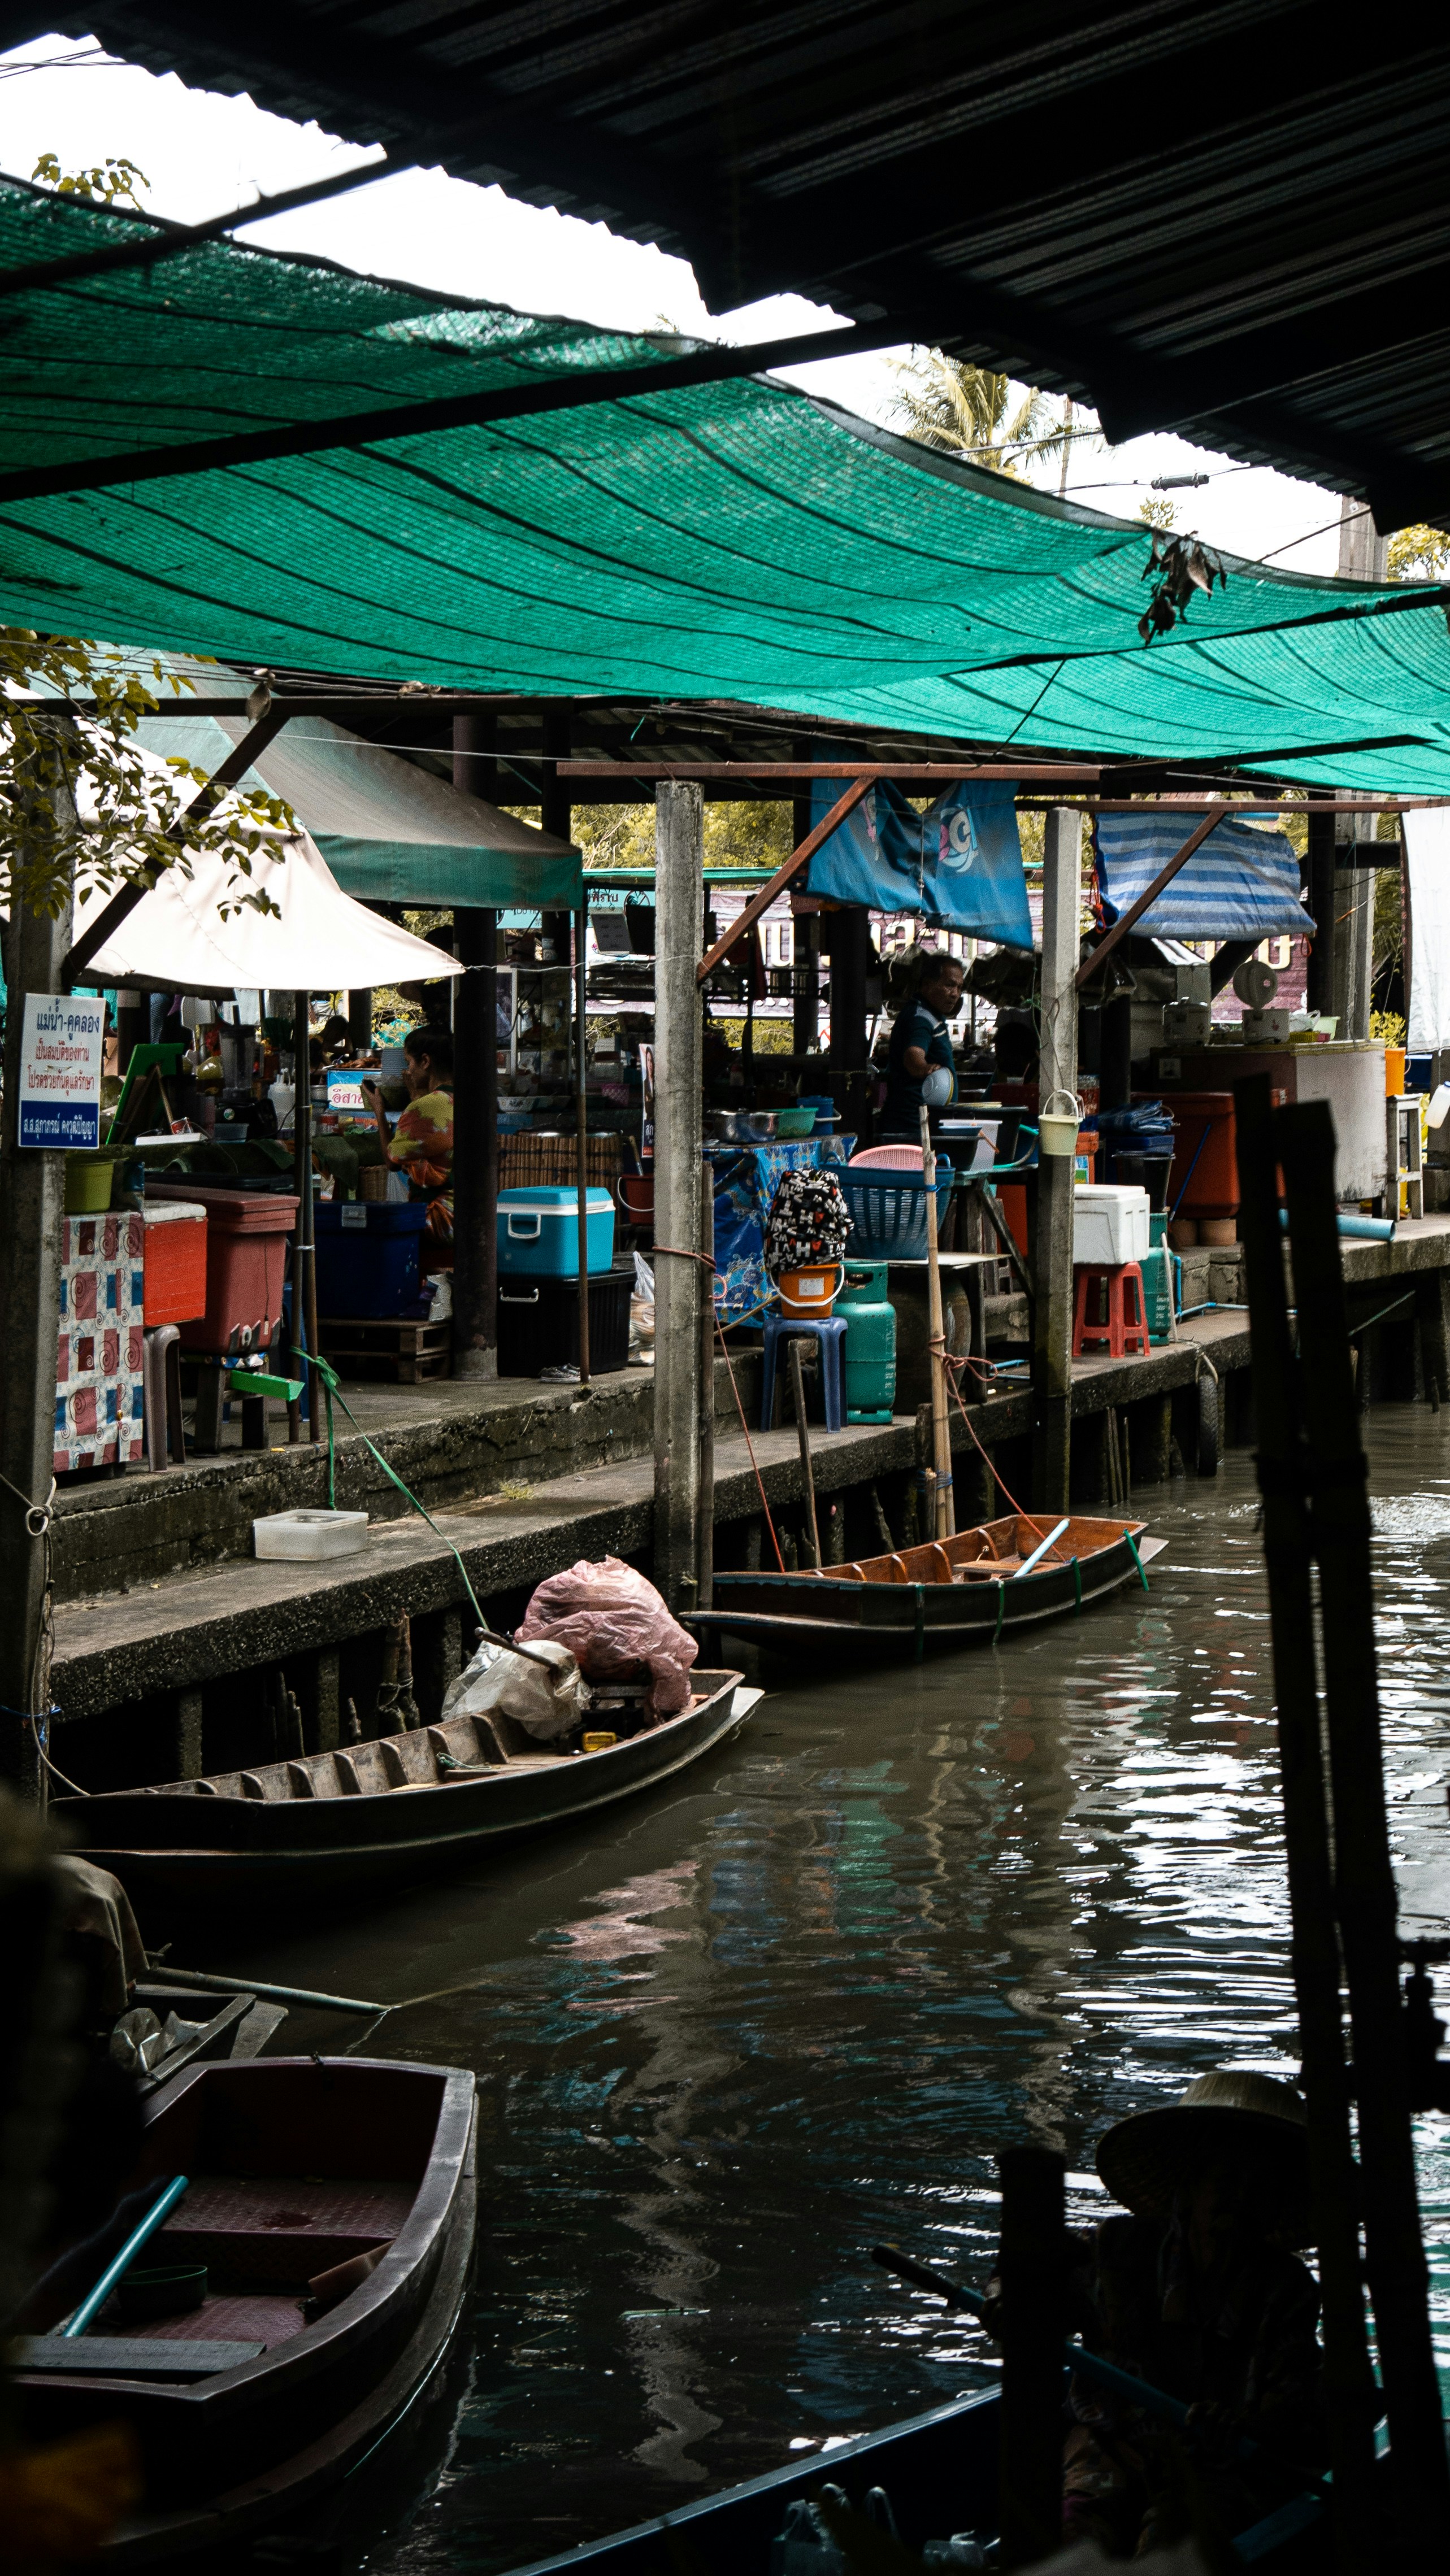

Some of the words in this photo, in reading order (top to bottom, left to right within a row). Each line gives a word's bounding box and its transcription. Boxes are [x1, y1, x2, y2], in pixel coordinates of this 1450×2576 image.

[37, 998, 100, 1041] แม่น้ำ-คูคลอง
[36, 1038, 90, 1062] เป็นสมบัติของท่าน
